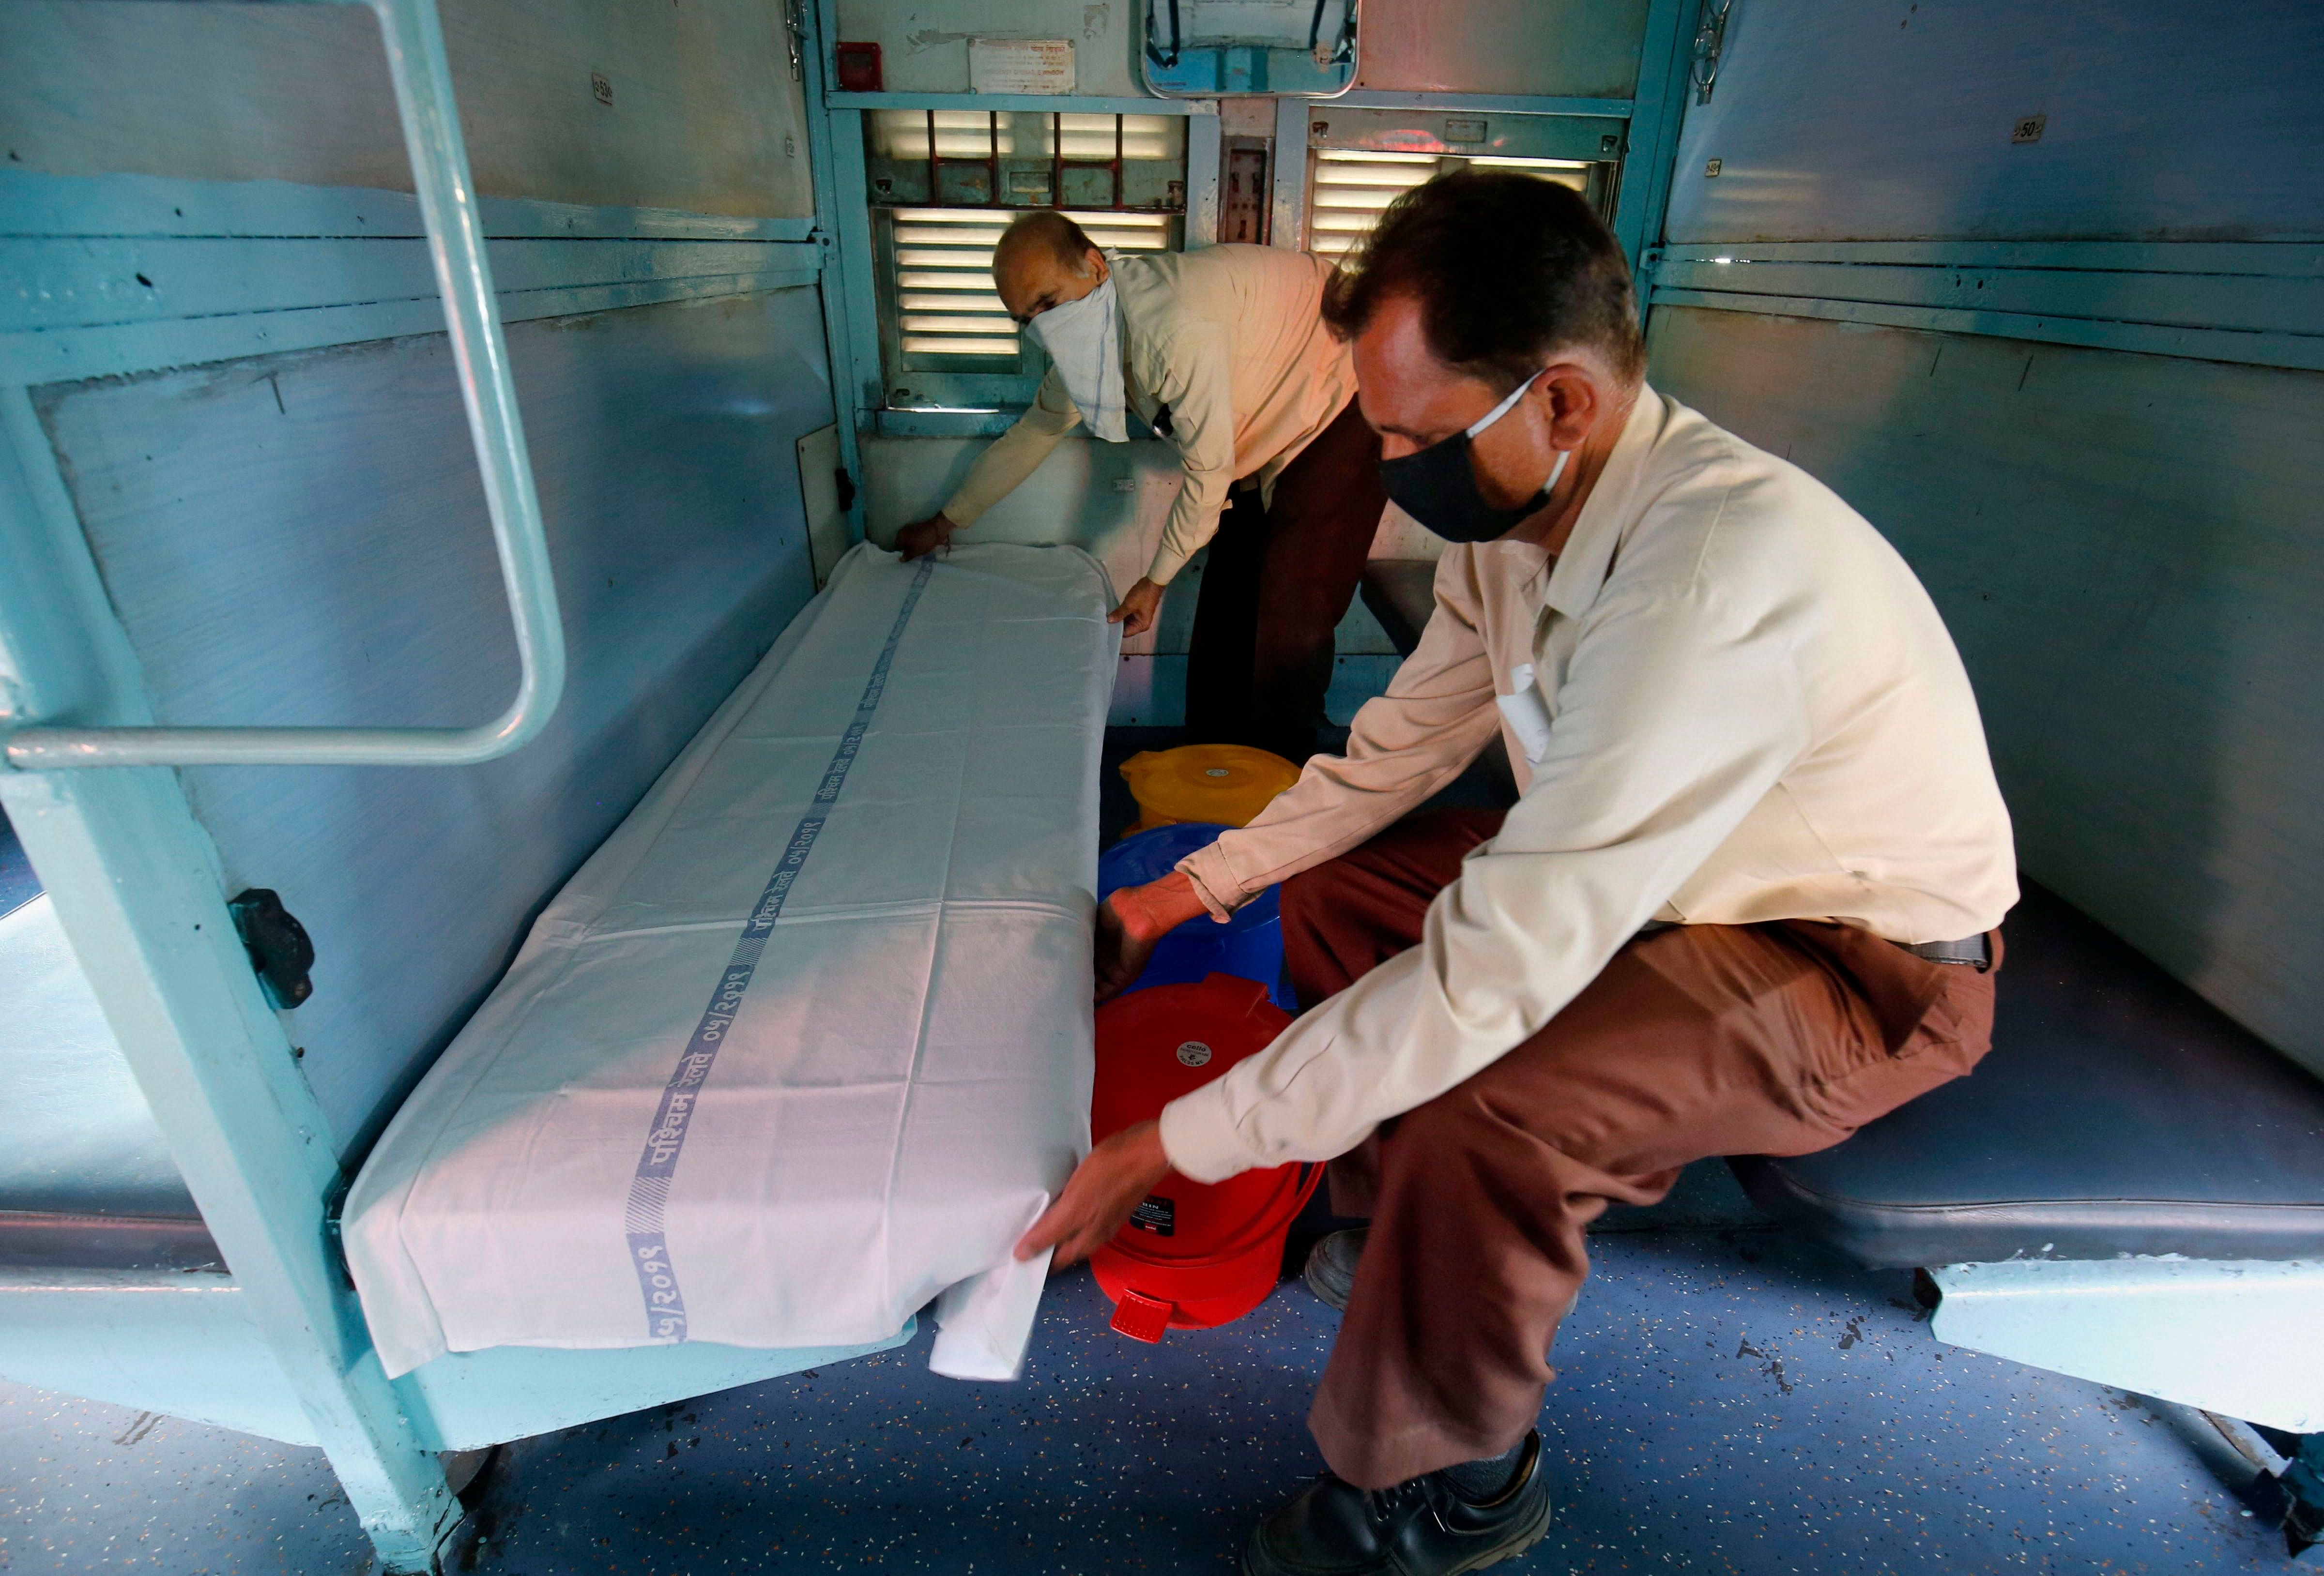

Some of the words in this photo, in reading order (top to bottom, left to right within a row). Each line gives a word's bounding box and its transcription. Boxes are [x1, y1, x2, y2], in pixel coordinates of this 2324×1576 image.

[2021, 121, 2035, 137] 50
[703, 971, 750, 1041] ०५/२०१९
[668, 1052, 713, 1088] रेलवे
[648, 1092, 693, 1166] पश्चिम
